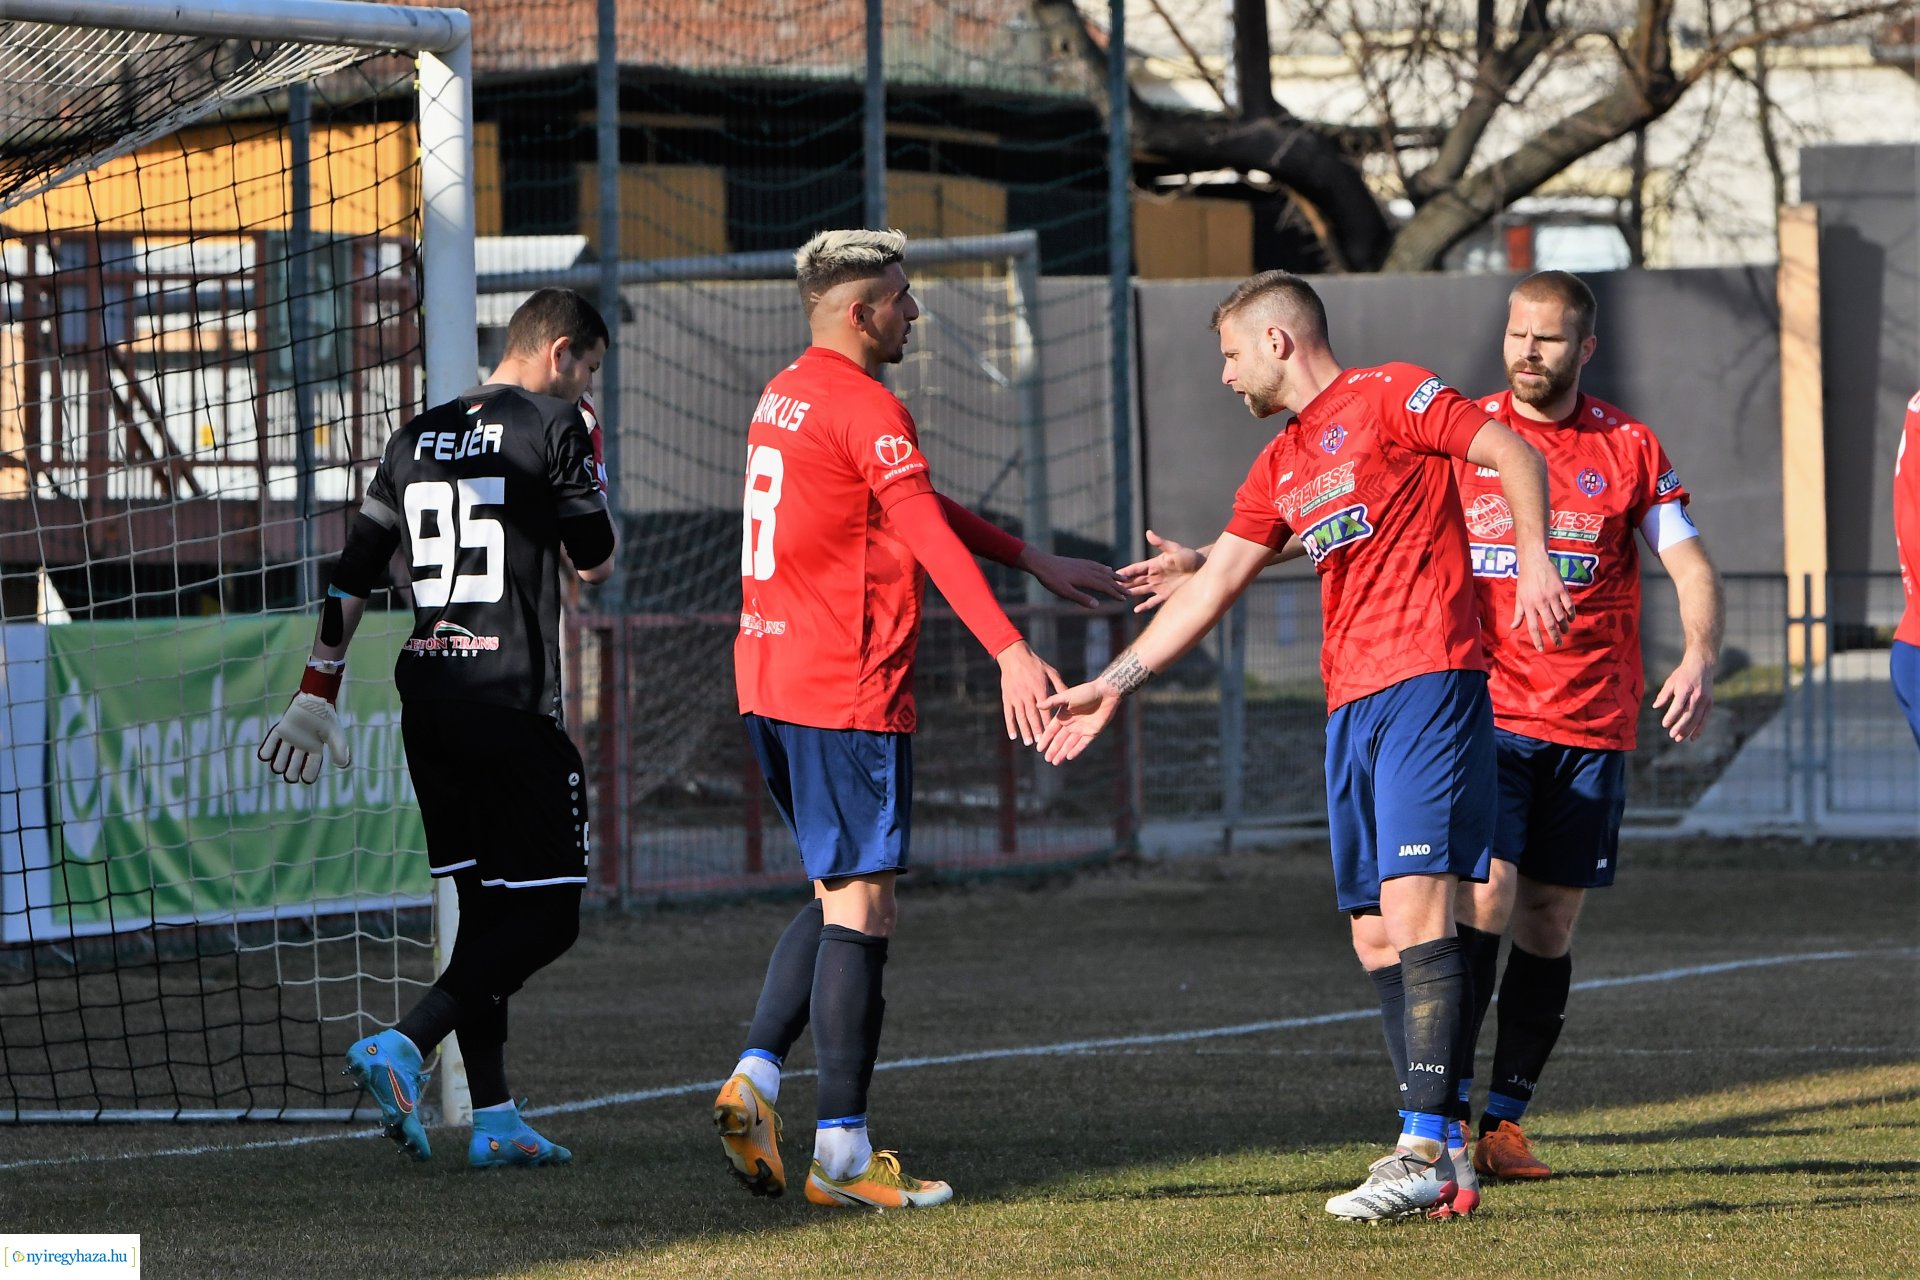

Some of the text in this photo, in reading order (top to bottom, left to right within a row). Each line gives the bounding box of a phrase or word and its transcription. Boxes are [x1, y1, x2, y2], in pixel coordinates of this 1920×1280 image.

[414, 418, 504, 460] FEJÉR
[403, 477, 505, 607] 95
[449, 635, 500, 651] TRANS
[1398, 843, 1431, 857] JAKO
[1408, 1061, 1445, 1075] JAKO
